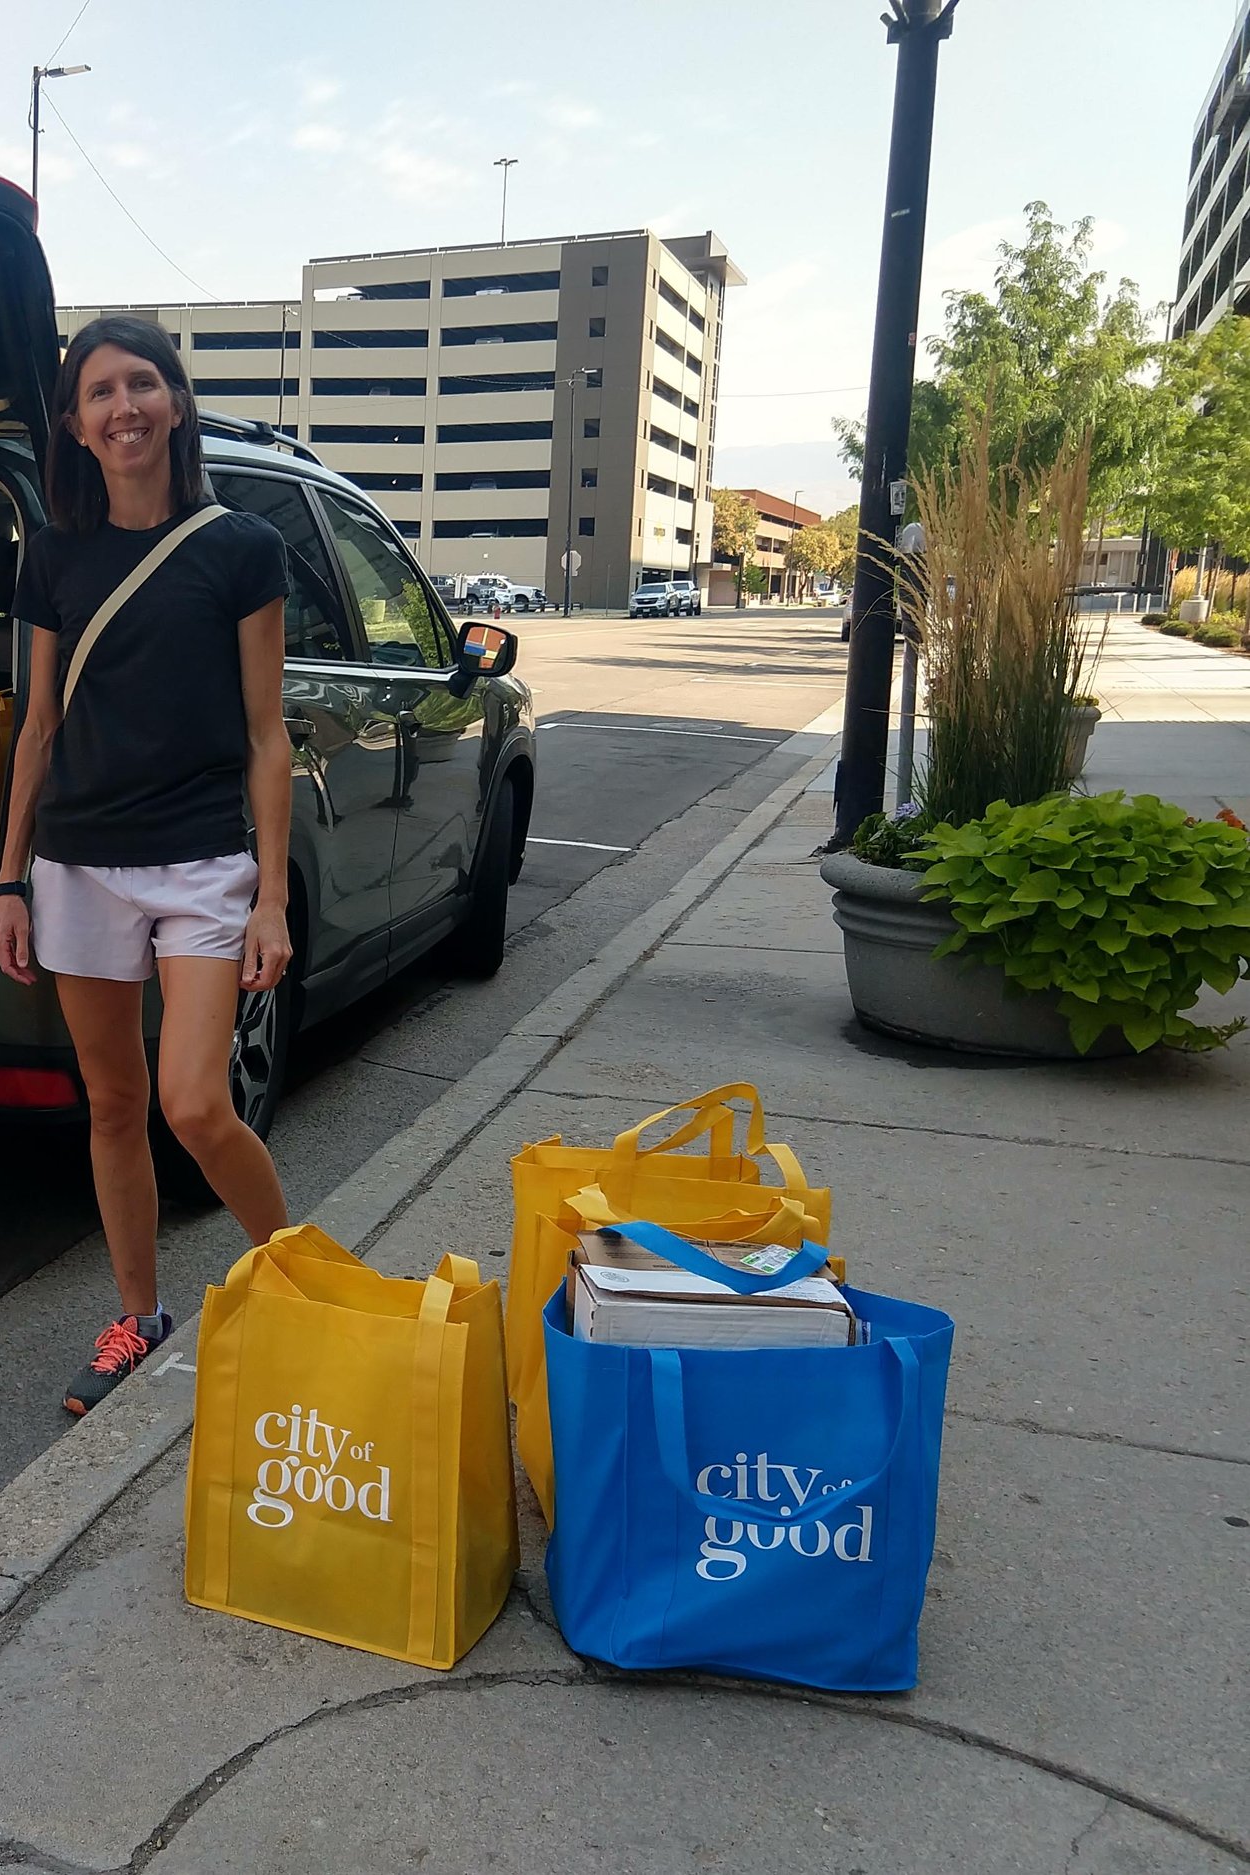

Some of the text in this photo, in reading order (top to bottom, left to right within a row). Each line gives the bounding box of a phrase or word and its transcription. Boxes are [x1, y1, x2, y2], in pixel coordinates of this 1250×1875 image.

[254, 1404, 375, 1476] city of
[246, 1455, 394, 1528] good
[696, 1452, 824, 1516] city
[695, 1505, 874, 1581] good
